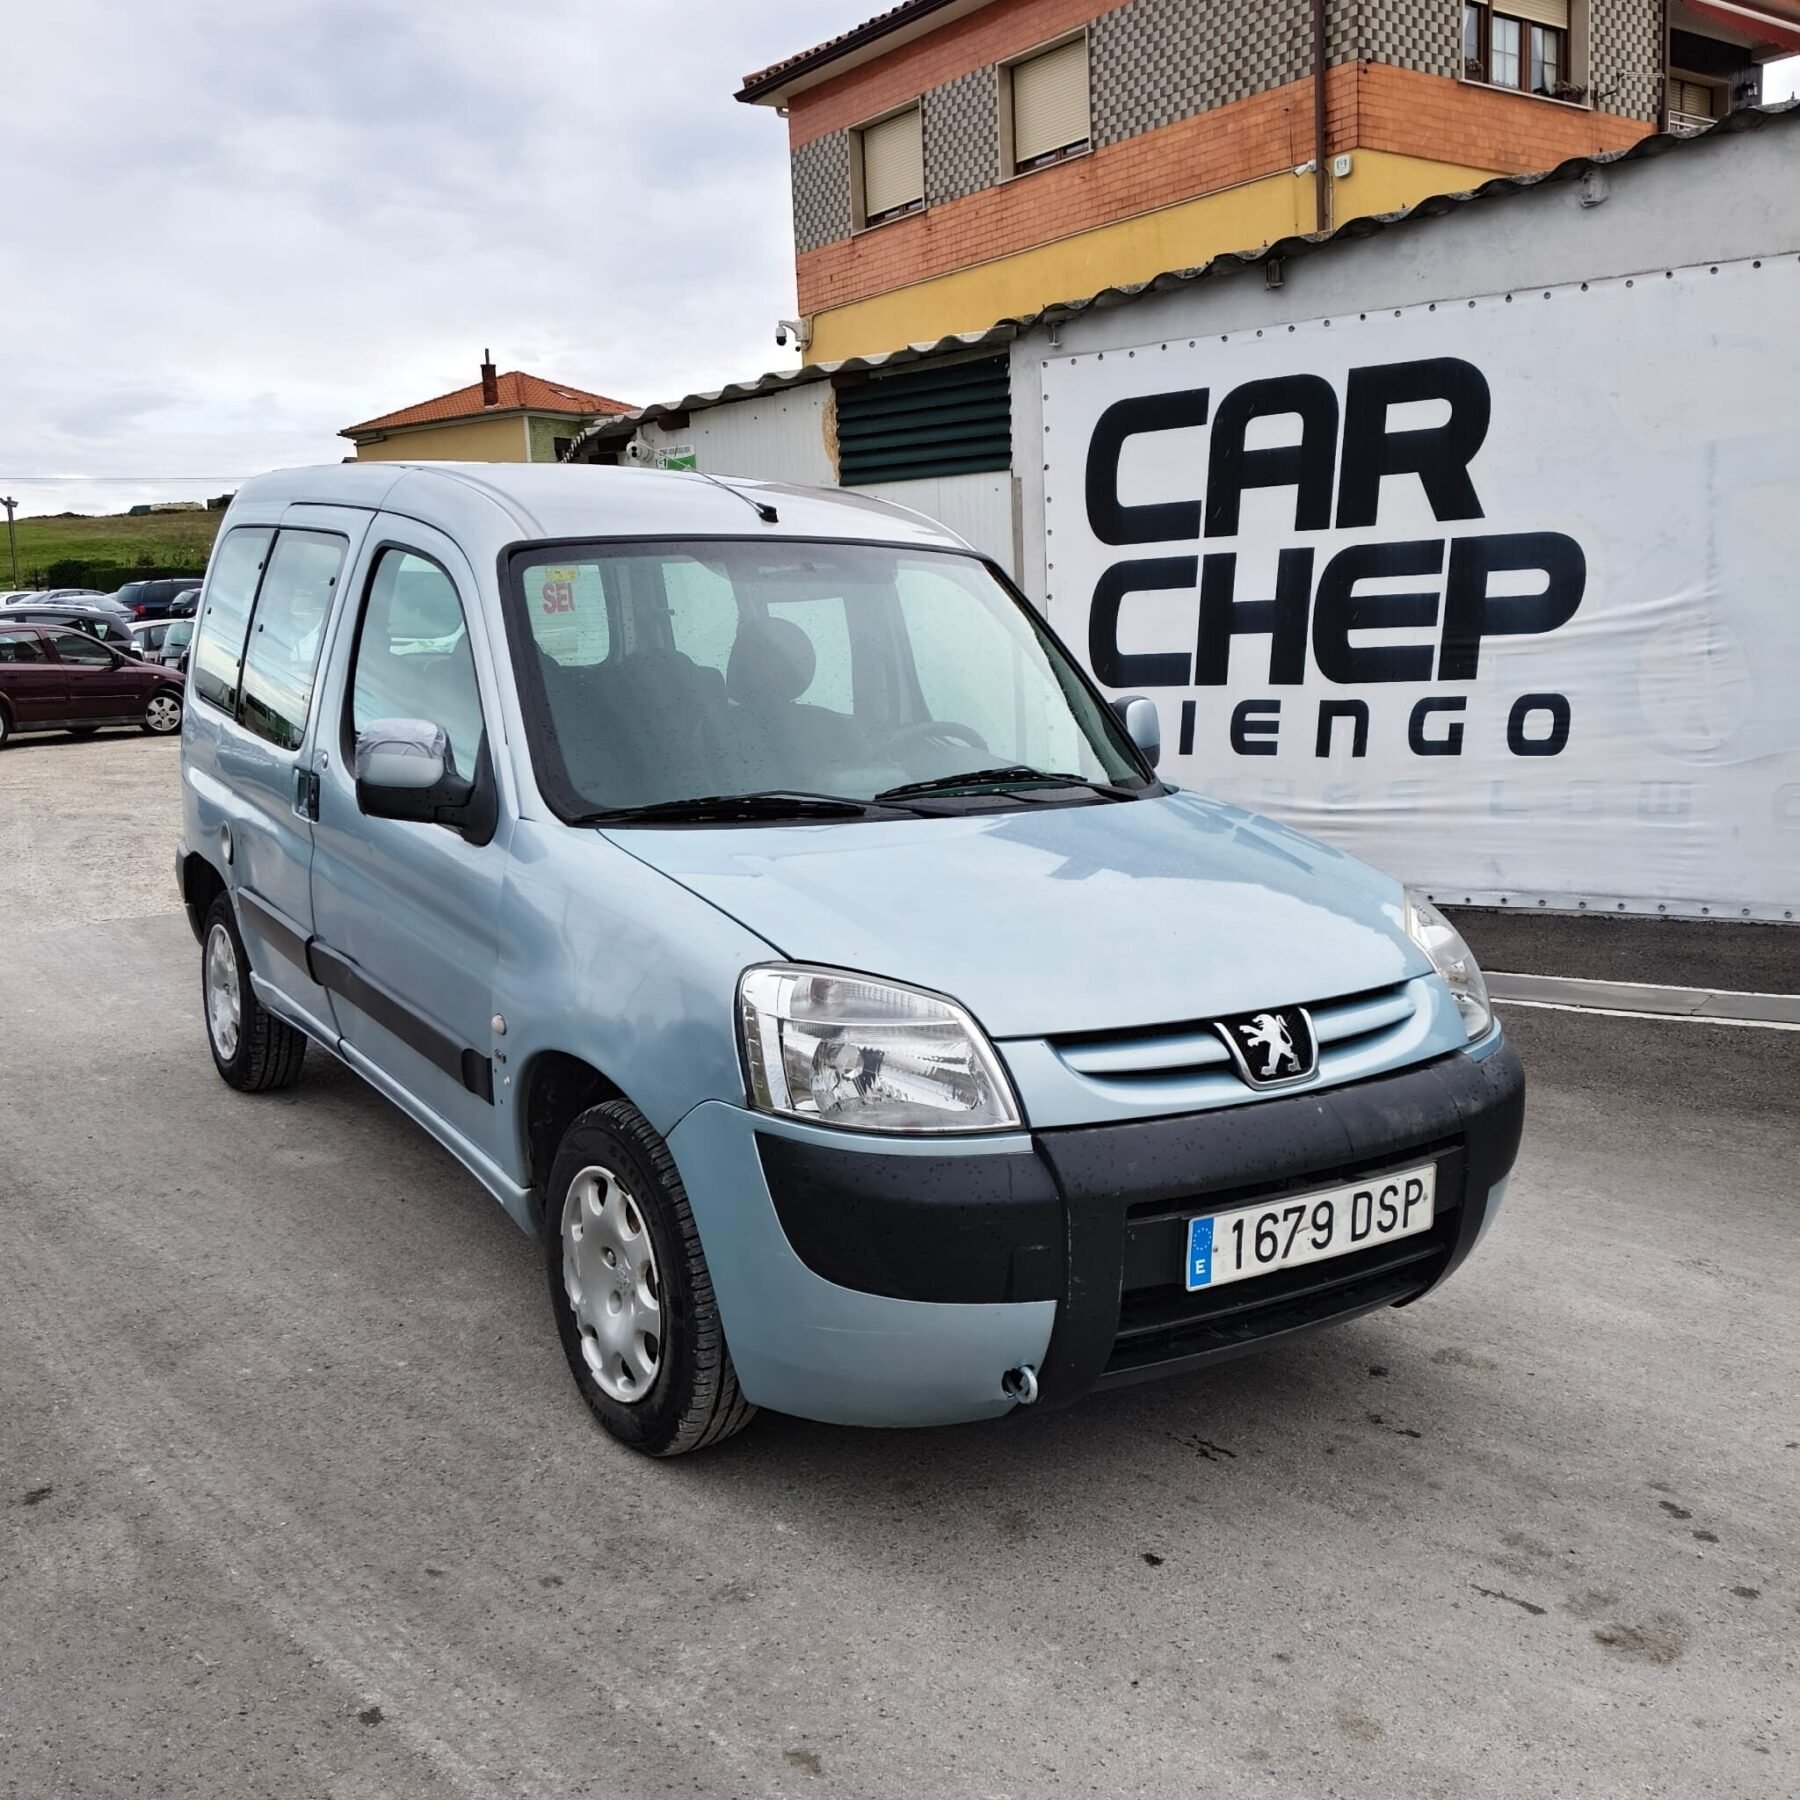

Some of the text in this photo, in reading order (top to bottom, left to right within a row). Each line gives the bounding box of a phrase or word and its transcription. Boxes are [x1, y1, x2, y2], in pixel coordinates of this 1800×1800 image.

[1085, 357, 1491, 546] CAR
[1088, 531, 1587, 688] CHEP
[1178, 694, 1571, 757] IENGO
[1195, 1259, 1206, 1275] E
[1232, 1178, 1424, 1270] 1679 DSP
